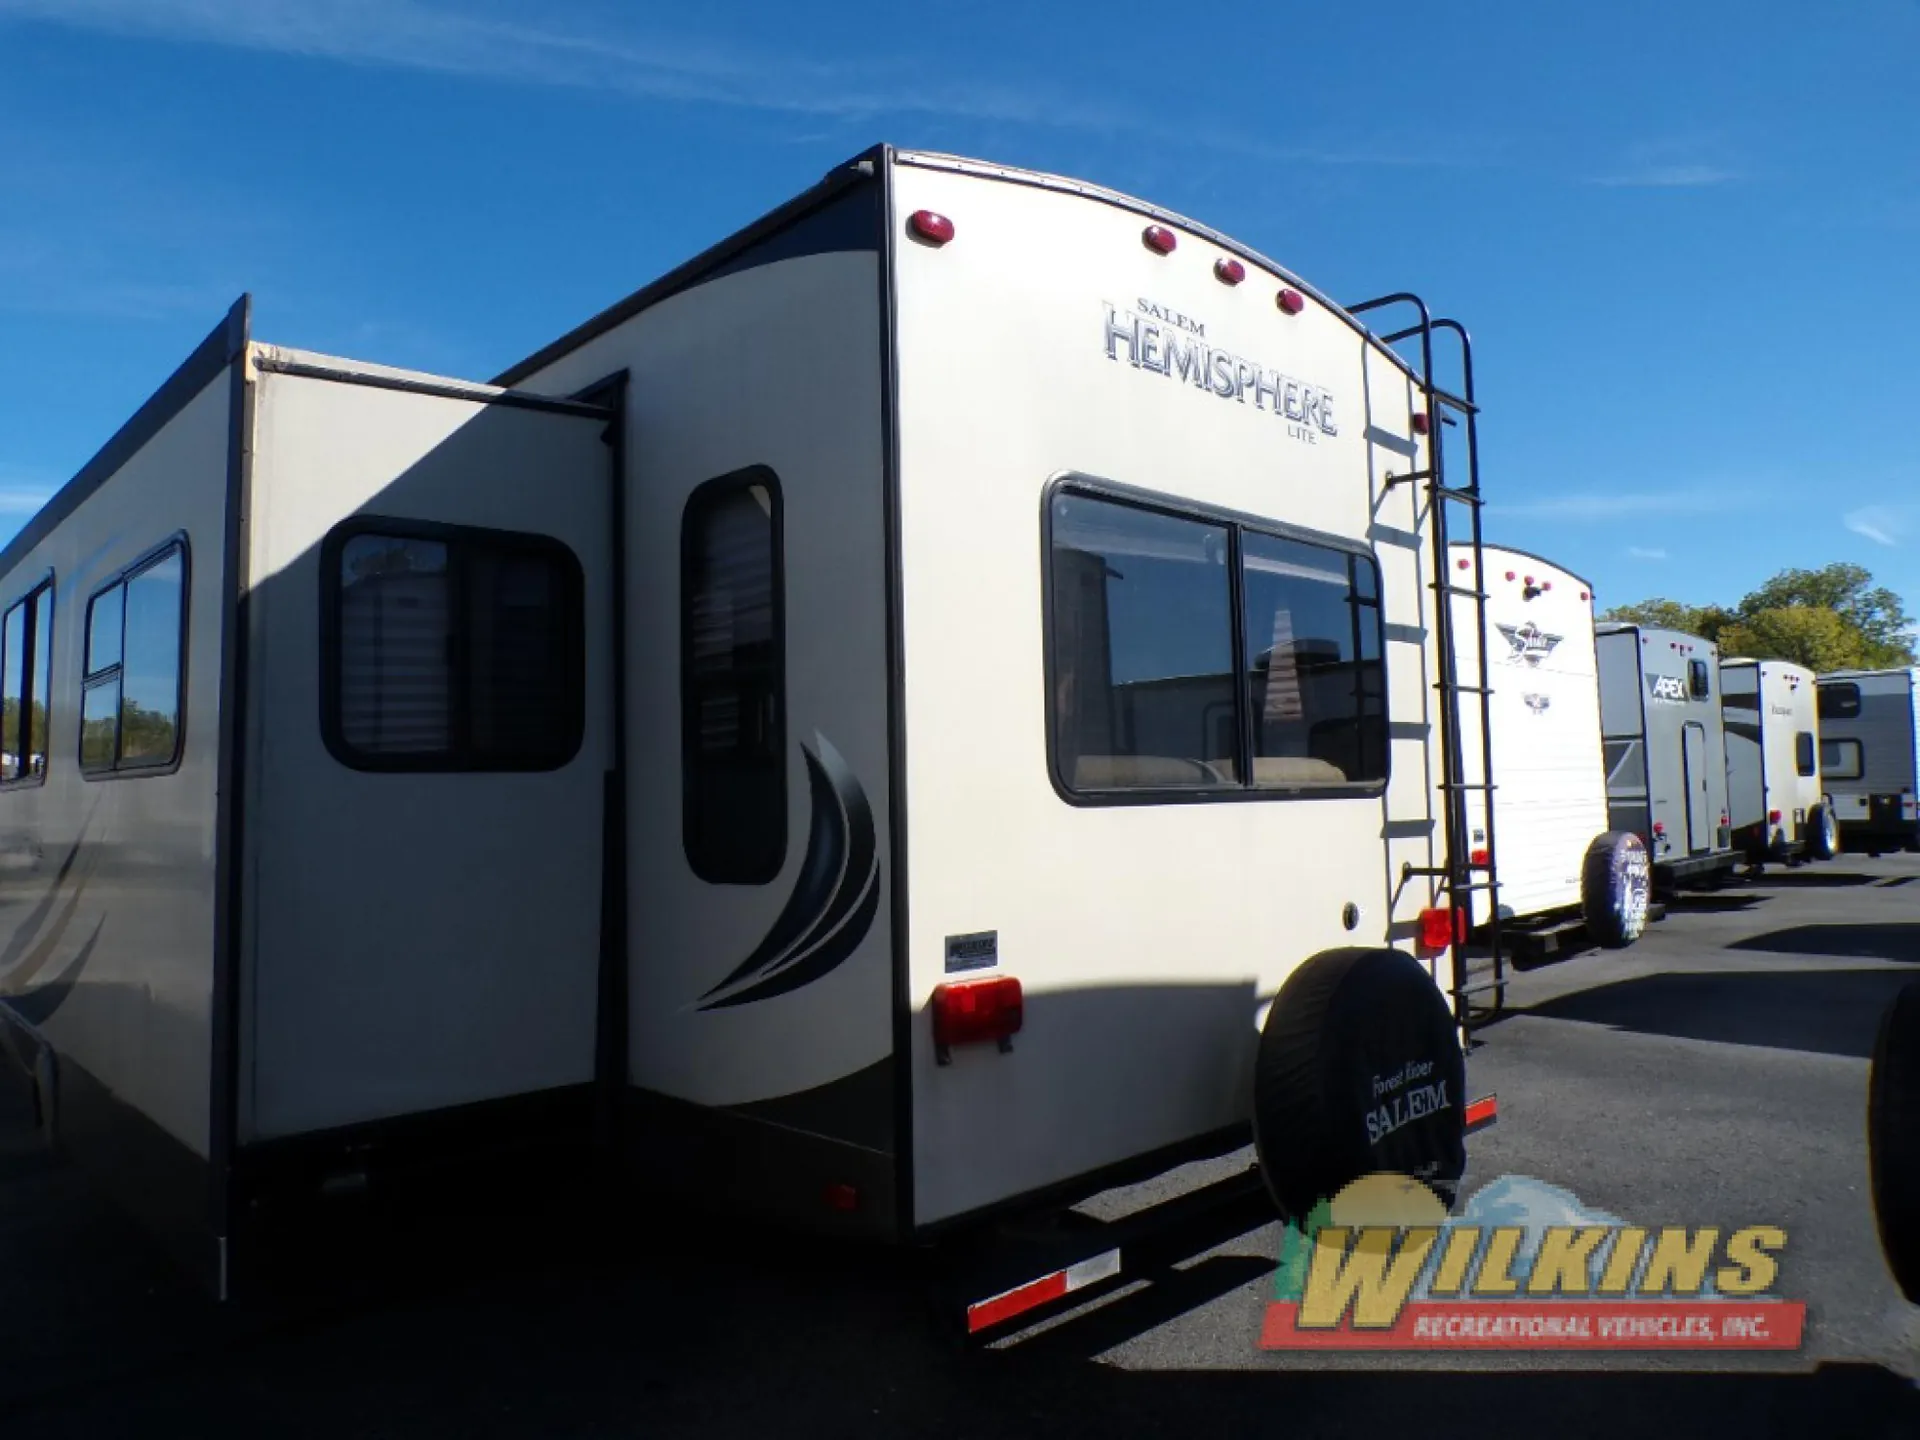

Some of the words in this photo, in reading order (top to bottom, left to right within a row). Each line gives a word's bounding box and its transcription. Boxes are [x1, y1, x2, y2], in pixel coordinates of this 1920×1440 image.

[1137, 297, 1205, 337] SALEM
[1101, 299, 1338, 437] HEMISPHERE
[1287, 423, 1317, 445] LITE
[1366, 1079, 1452, 1146] SALEM
